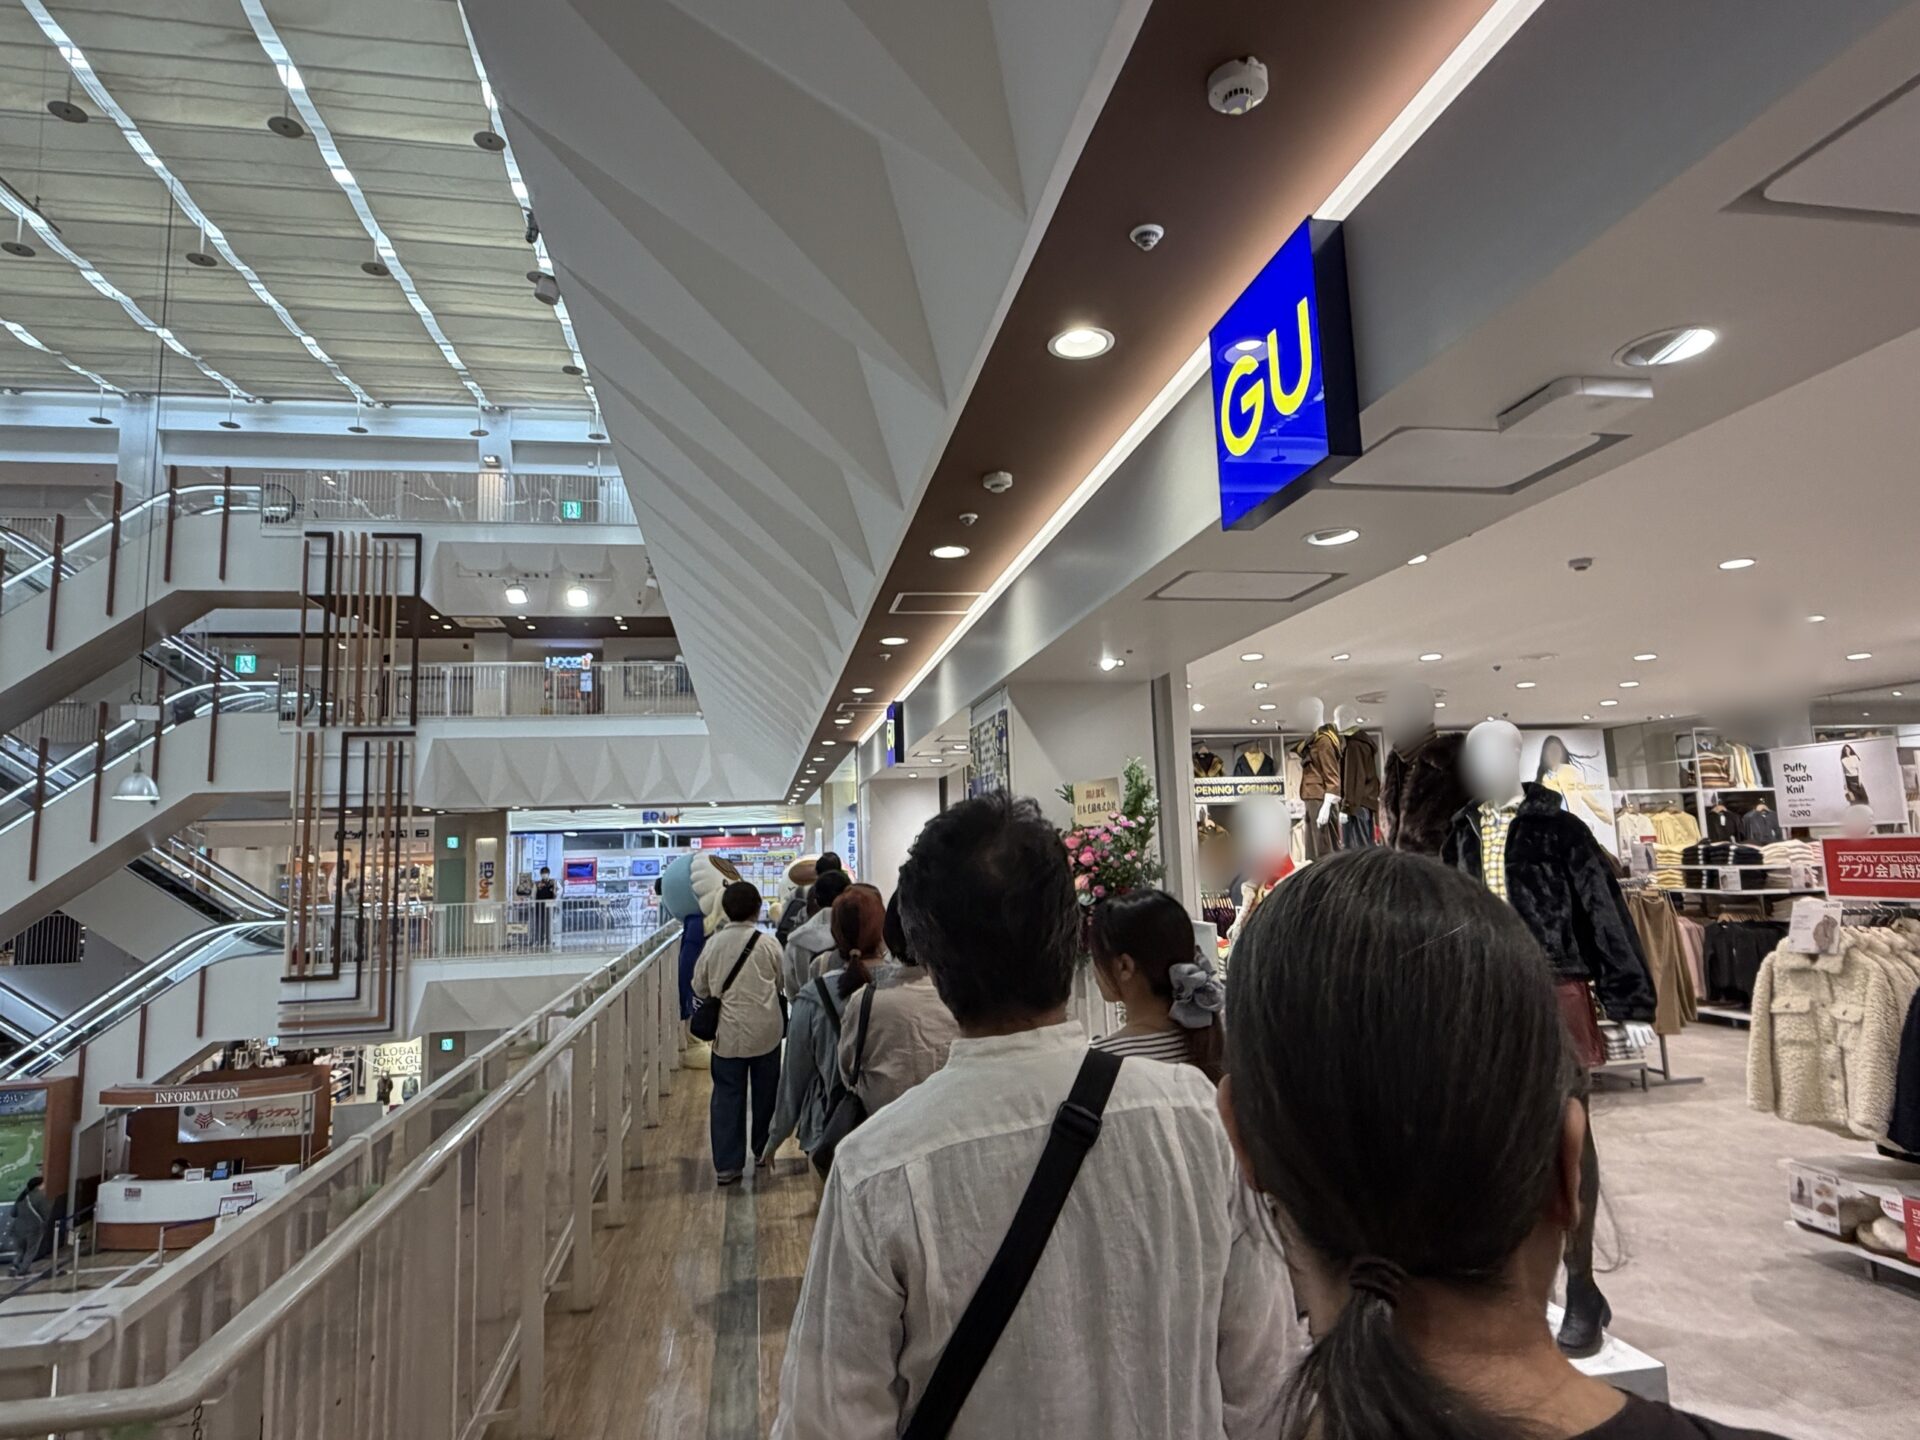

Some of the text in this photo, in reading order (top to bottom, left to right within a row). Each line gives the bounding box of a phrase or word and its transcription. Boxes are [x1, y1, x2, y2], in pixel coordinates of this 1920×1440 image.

[1221, 296, 1312, 457] GU
[1783, 763, 1807, 773] Puffy
[1784, 774, 1813, 783] Touch
[1786, 785, 1805, 794] Knit
[1838, 855, 1878, 863] APP-ONLY
[373, 1046, 421, 1057] GLOBAL
[155, 1088, 239, 1104] INFORMATION
